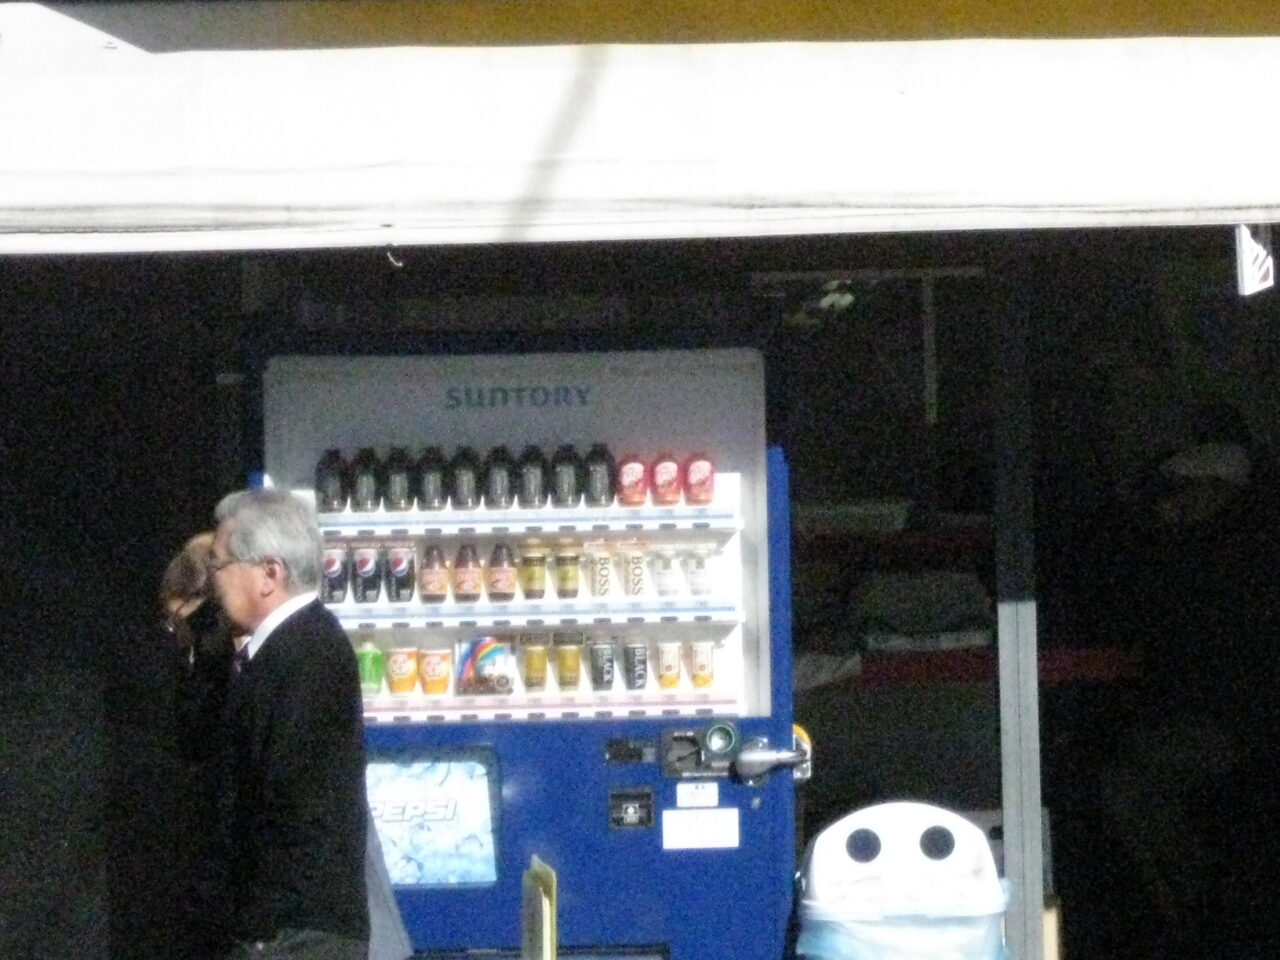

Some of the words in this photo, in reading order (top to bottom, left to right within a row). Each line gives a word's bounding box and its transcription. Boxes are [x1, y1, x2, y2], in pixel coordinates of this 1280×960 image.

[446, 385, 593, 409] SUNTORY
[598, 556, 610, 597] BOSS
[631, 555, 644, 596] BOSS
[602, 647, 614, 683] BLACK
[633, 647, 647, 688] BLACK
